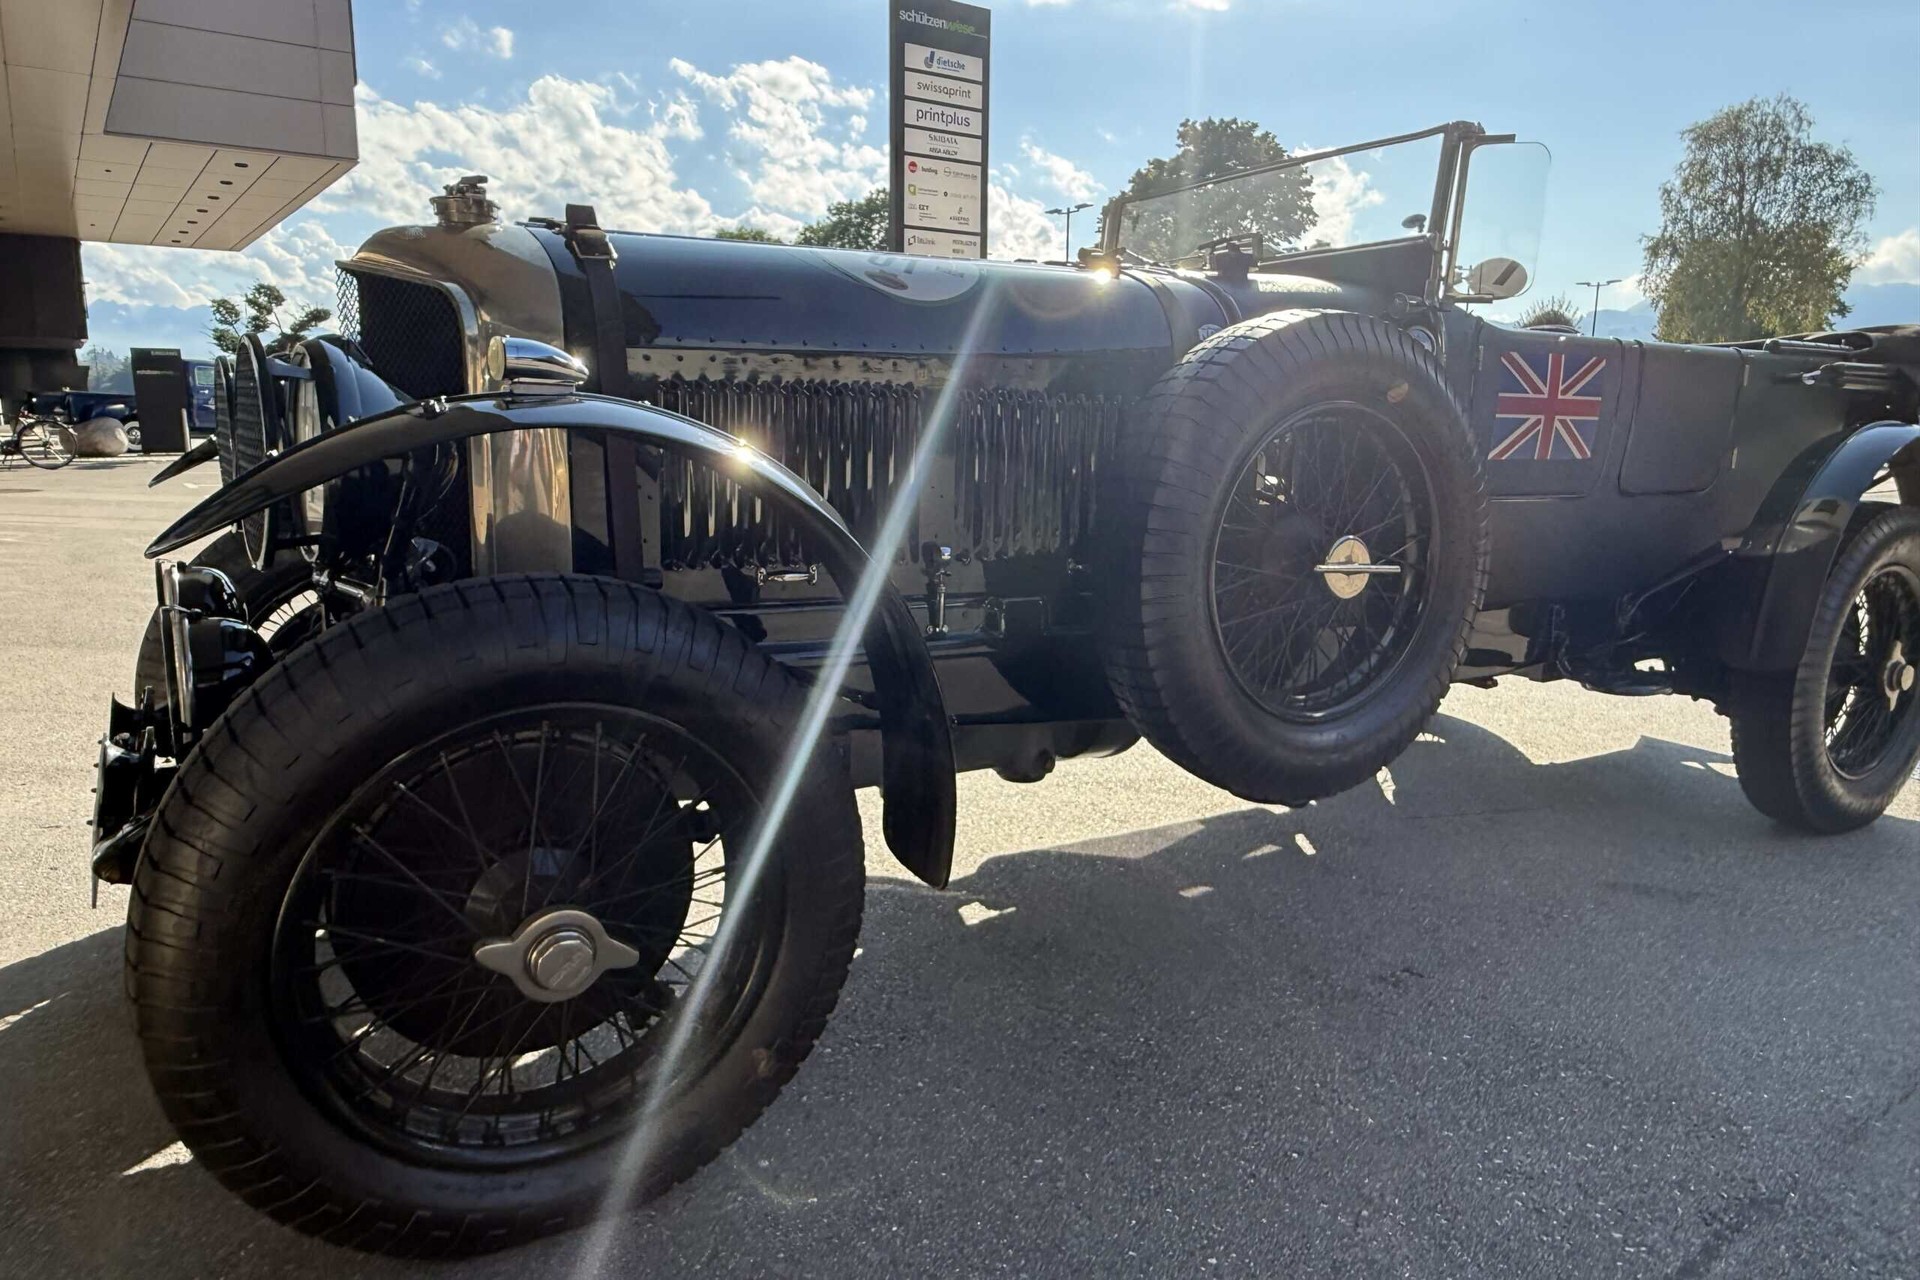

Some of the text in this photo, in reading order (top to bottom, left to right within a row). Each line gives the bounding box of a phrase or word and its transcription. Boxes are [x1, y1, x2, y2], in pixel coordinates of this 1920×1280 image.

[899, 10, 976, 34] schützenwiese
[936, 56, 966, 70] dietsche
[916, 107, 971, 127] printplus
